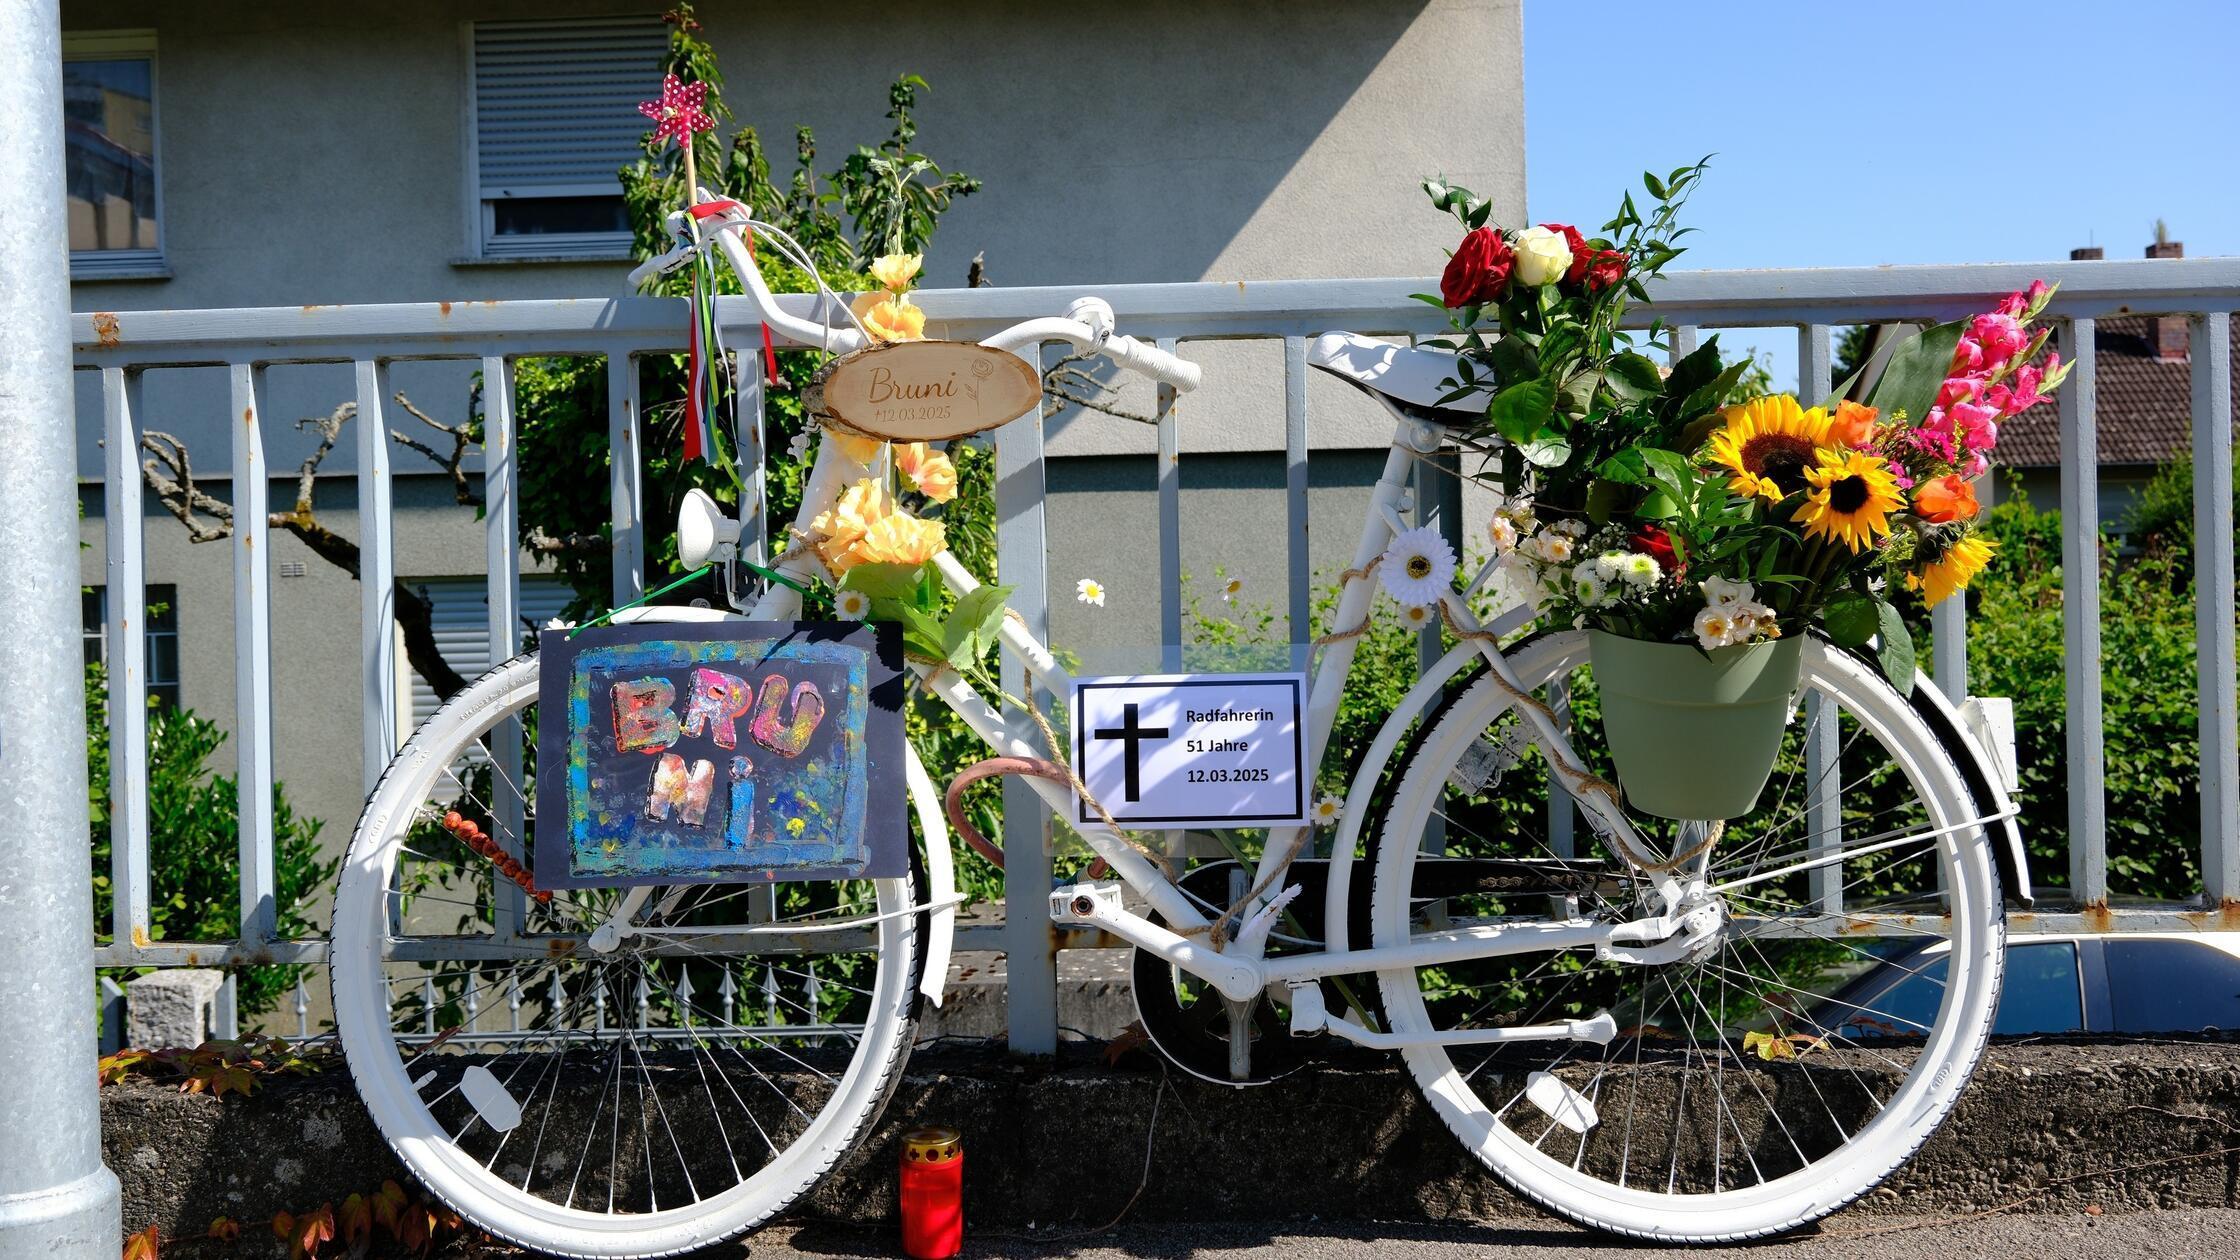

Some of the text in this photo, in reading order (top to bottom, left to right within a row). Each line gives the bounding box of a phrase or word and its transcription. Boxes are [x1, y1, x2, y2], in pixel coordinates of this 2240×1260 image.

[869, 366, 958, 404] Bruni
[610, 668, 826, 759] BRU
[1186, 708, 1274, 723] Radfahrerin
[1186, 738, 1249, 753] 51 Jahre
[1187, 768, 1269, 783] 12.03.2025
